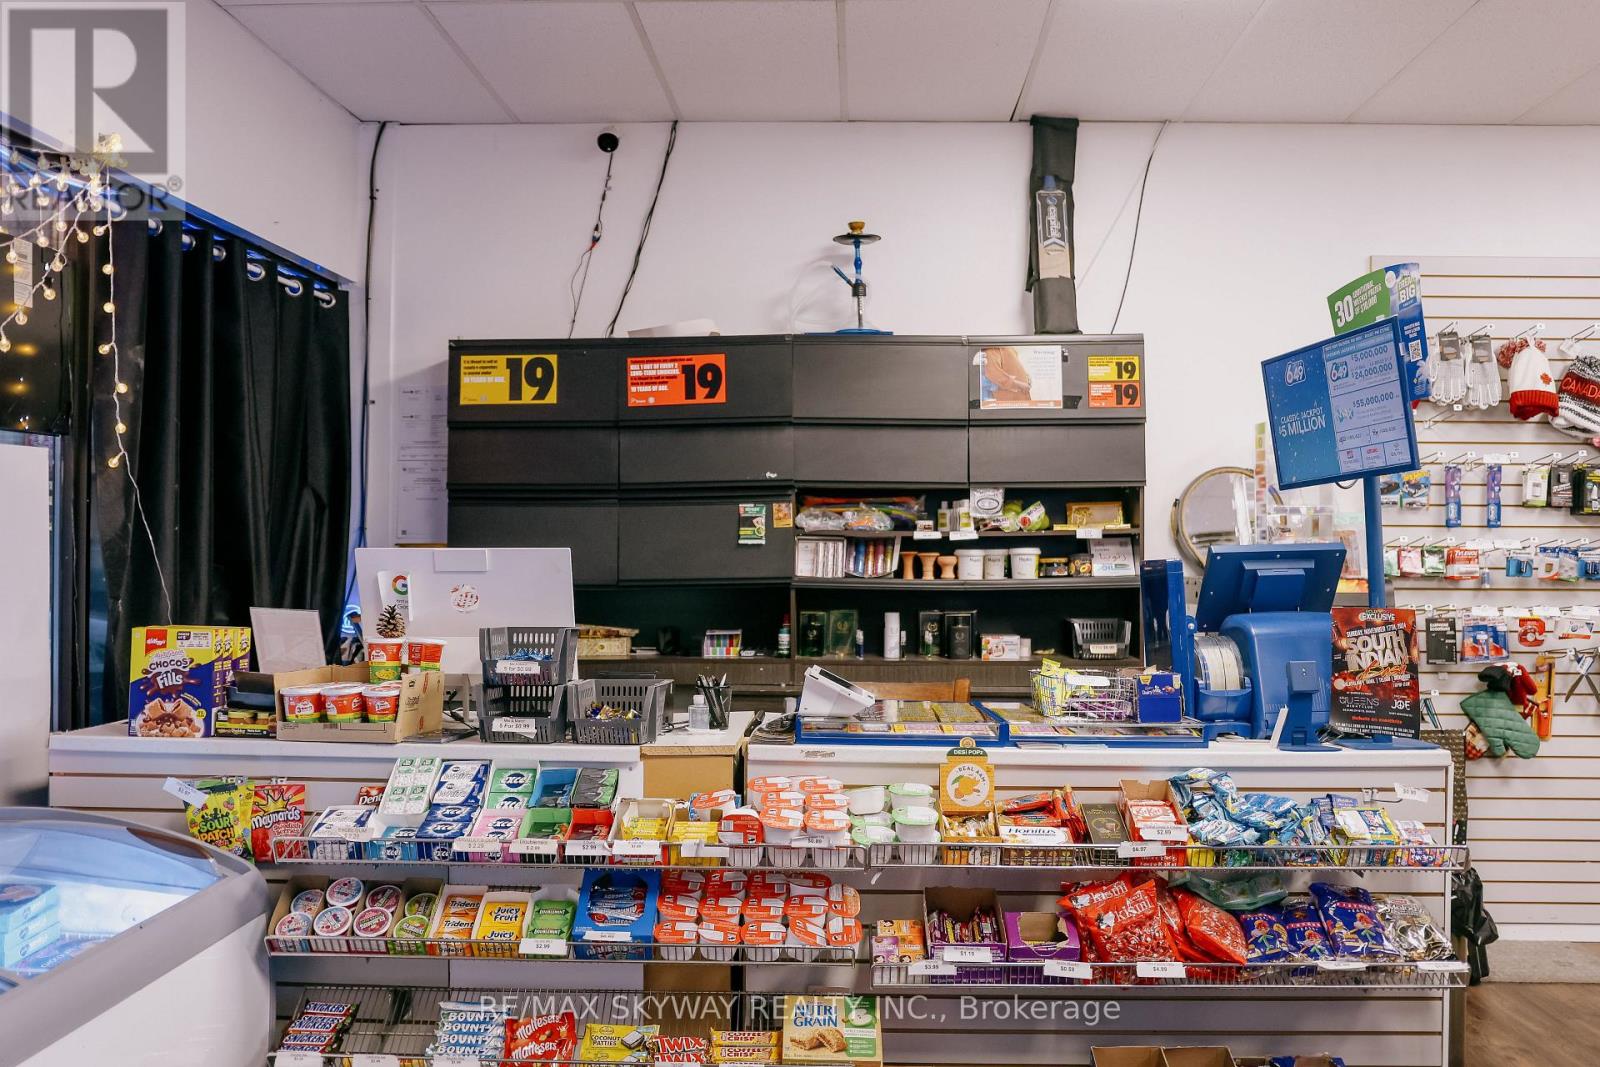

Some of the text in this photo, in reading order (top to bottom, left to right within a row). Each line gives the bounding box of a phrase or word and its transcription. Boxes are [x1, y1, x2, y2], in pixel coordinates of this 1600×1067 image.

[1335, 295, 1354, 327] 30
[1115, 361, 1136, 379] 19
[506, 357, 555, 401] 19
[681, 363, 723, 400] 19
[1114, 384, 1138, 405] 19
[1288, 415, 1326, 436] MILLION
[1347, 630, 1406, 655] SOUTH
[149, 658, 188, 671] CHOCOS
[1347, 648, 1410, 672] INDIAN
[156, 671, 184, 690] Fills
[1339, 696, 1380, 707] QUEENS
[1391, 700, 1411, 711] JOE
[501, 774, 531, 785] excel
[200, 817, 232, 833] SOUR
[251, 808, 302, 830] Maynards
[196, 828, 235, 842] PATCH
[1008, 827, 1056, 836] Honitus
[450, 900, 480, 909] Trident
[493, 906, 521, 916] Juicy
[444, 920, 475, 929] Trident
[493, 913, 518, 923] Fruit
[488, 930, 514, 940] Juicy
[306, 1001, 348, 1013] SNICKERS
[794, 1004, 838, 1018] NUTRI
[447, 1011, 502, 1022] BOUNTY
[794, 1015, 838, 1028] GRAIN
[290, 1020, 334, 1030] SNICKERS
[442, 1022, 495, 1032] BOUNTY
[516, 1014, 561, 1041] Maltesers
[285, 1033, 328, 1043] SNICKERS
[438, 1034, 494, 1044] BOUNTY
[657, 1036, 706, 1053] TWIX
[511, 1040, 558, 1062] Maltesers
[654, 1051, 706, 1063] TWIX
